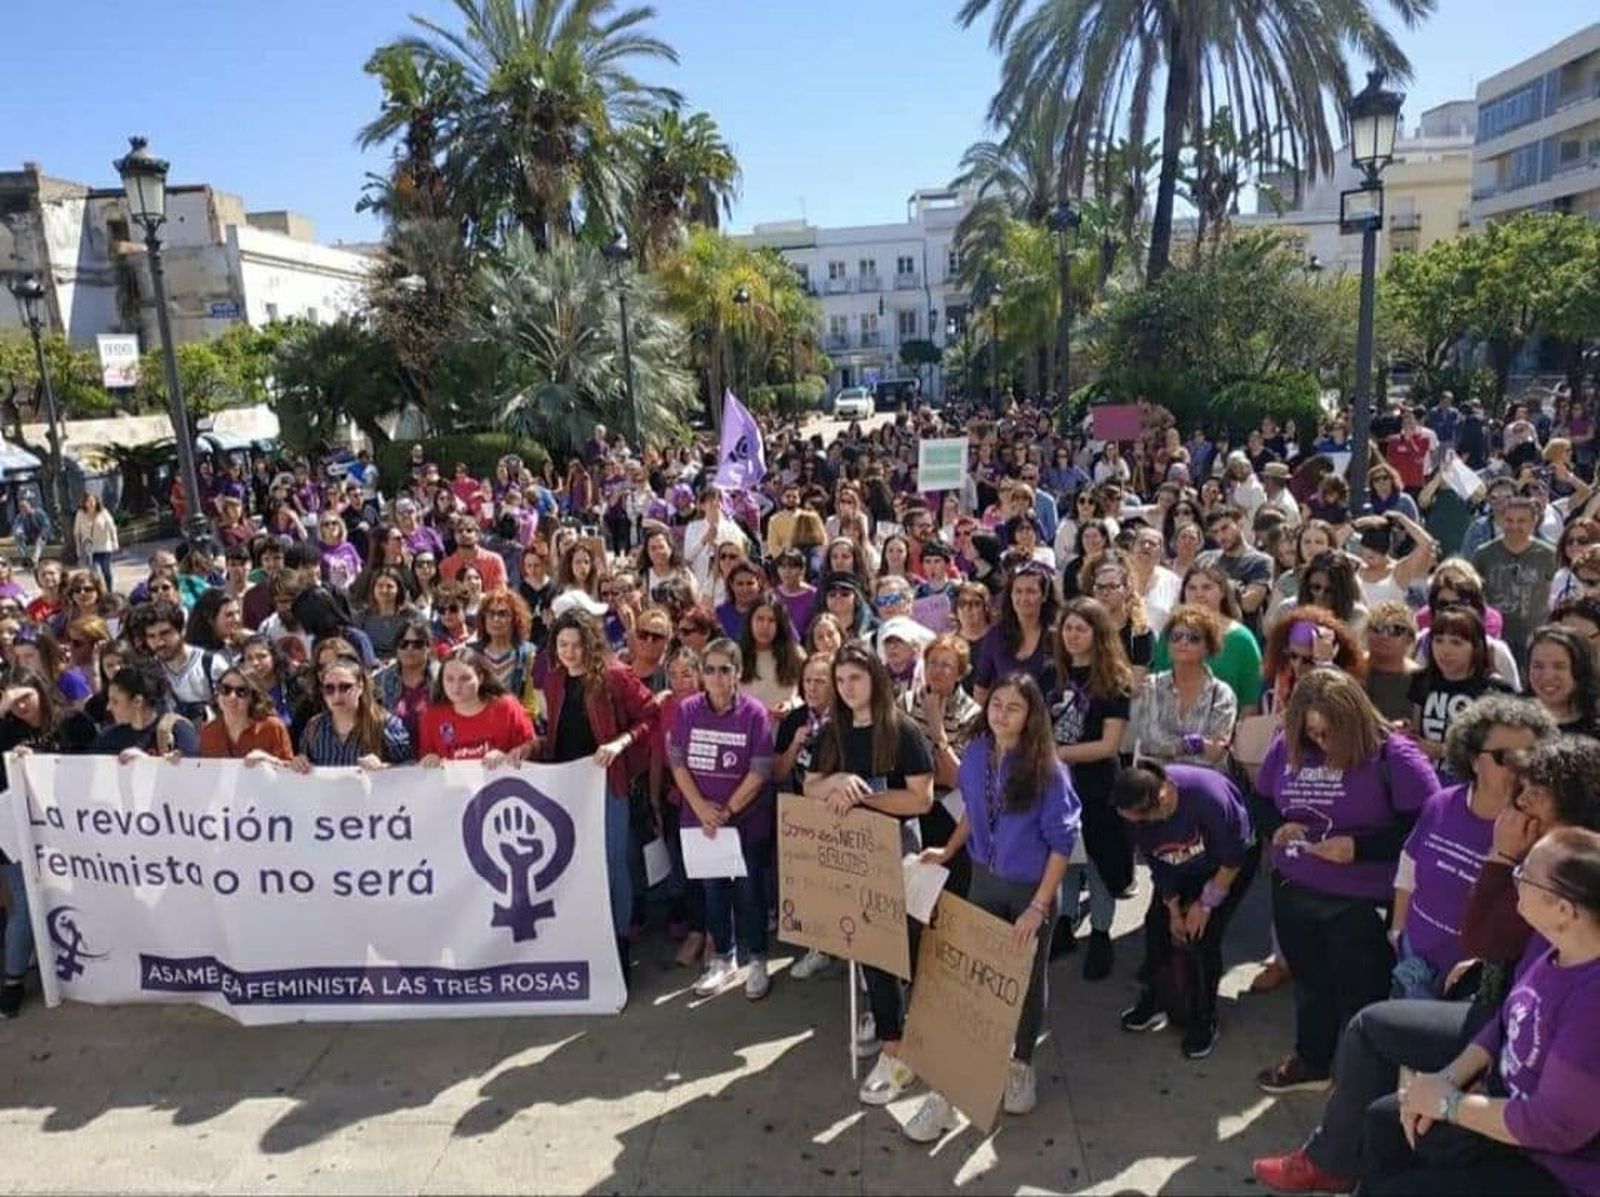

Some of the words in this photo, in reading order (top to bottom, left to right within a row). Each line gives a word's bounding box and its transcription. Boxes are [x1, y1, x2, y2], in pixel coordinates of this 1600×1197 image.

[26, 796, 65, 829] La
[76, 803, 293, 843] revolución
[314, 804, 413, 842] será
[35, 844, 204, 889] feminista
[213, 869, 240, 896] o
[260, 869, 315, 895] no
[334, 859, 433, 897] será
[247, 977, 375, 997] FEMINISTA
[383, 976, 427, 995] LAS
[434, 976, 493, 995] TRES
[501, 971, 580, 992] ROSAS
